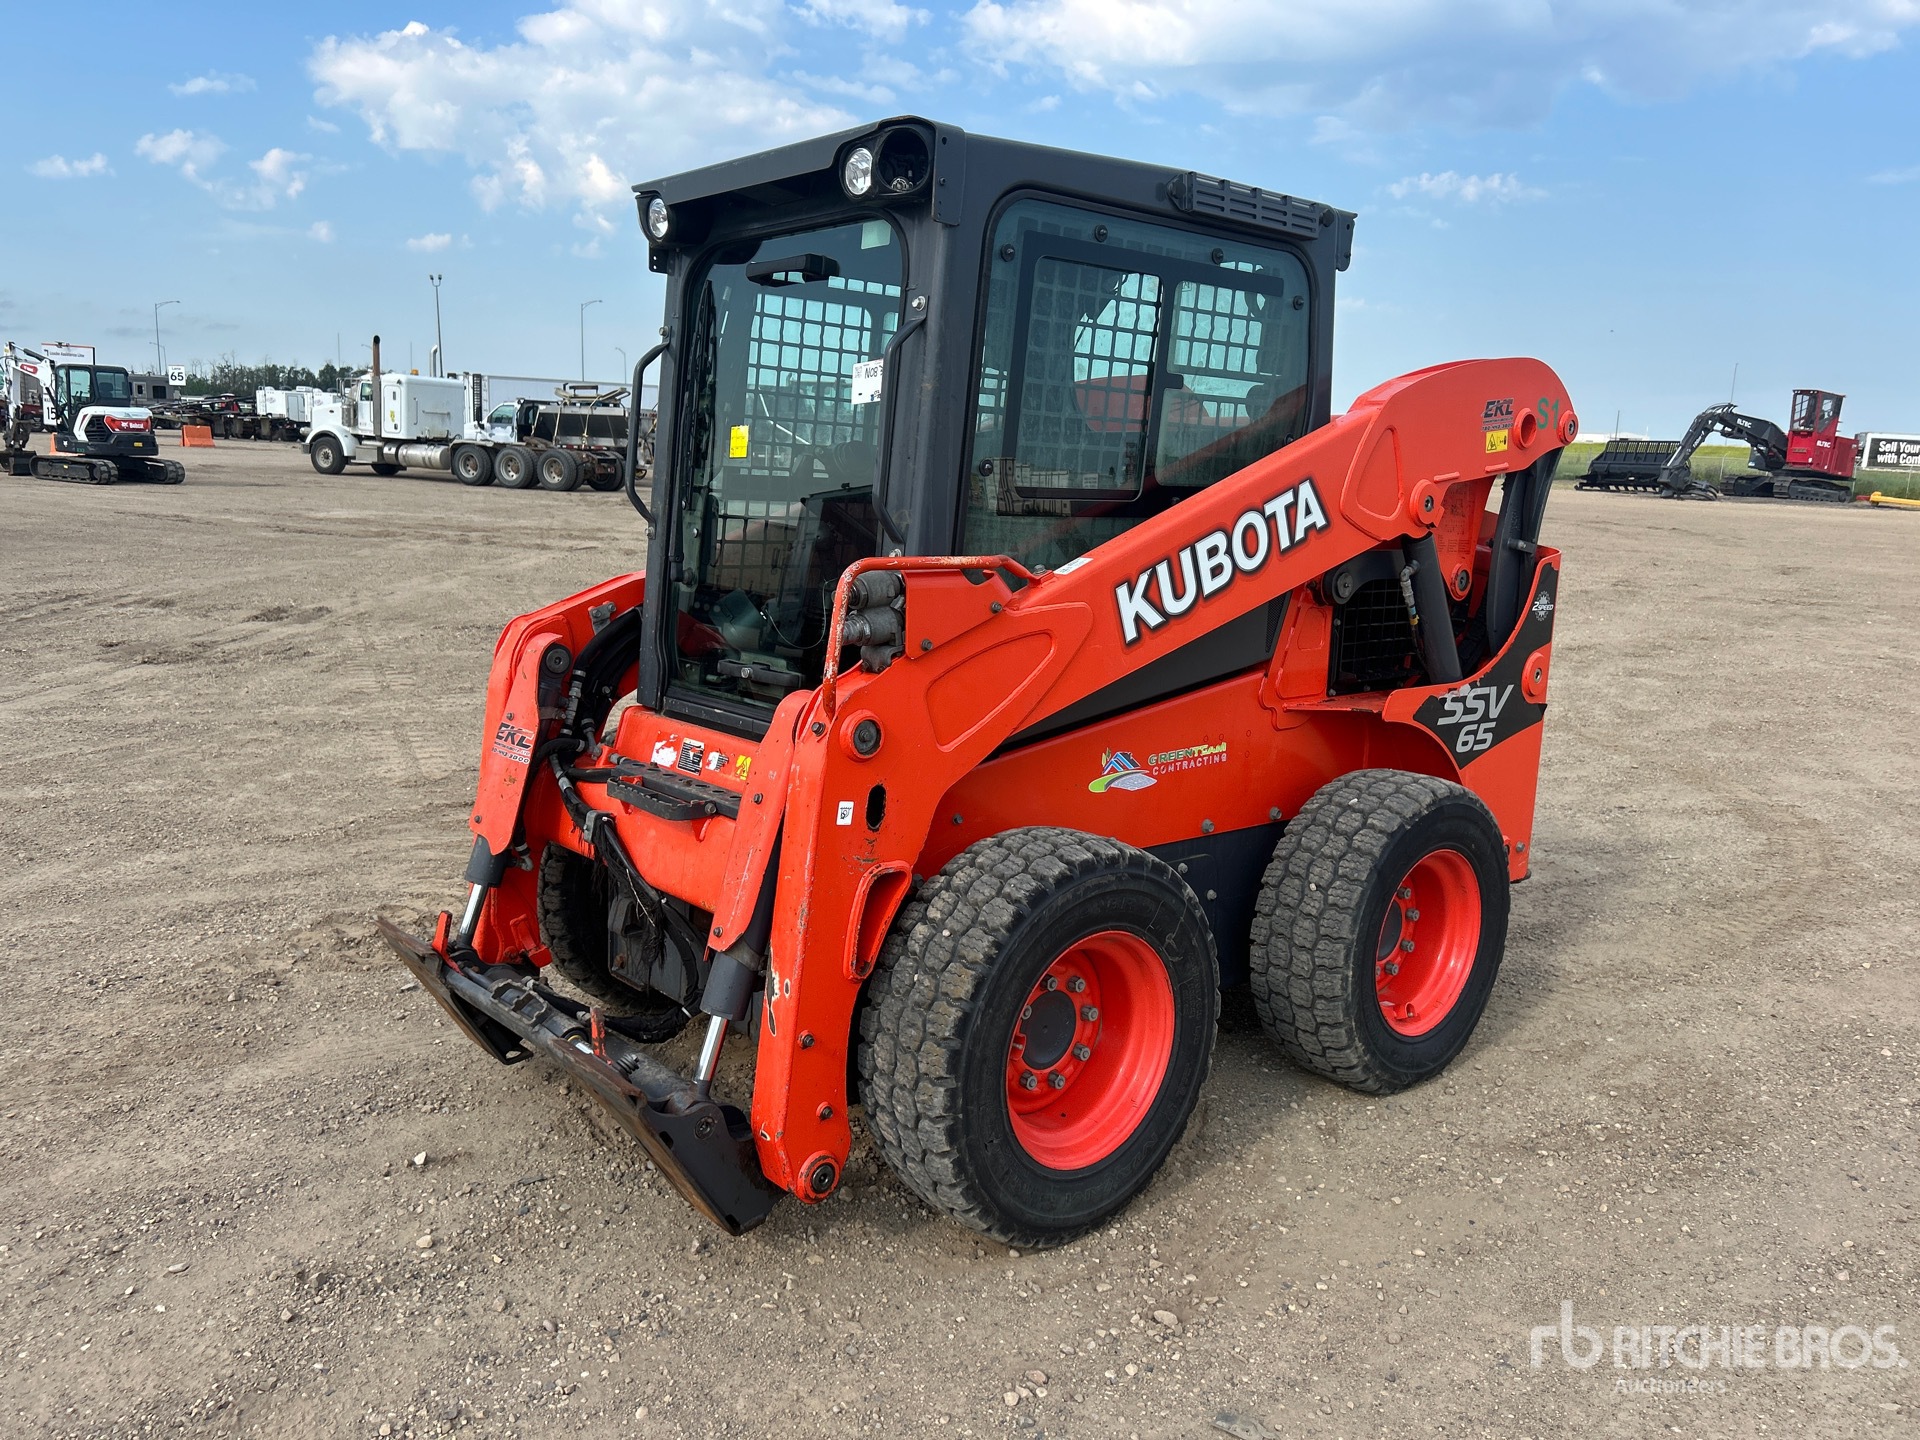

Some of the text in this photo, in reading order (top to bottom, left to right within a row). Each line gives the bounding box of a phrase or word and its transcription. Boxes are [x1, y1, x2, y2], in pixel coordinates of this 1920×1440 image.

[170, 371, 184, 381] 65
[46, 407, 57, 420] 15
[1483, 398, 1514, 419] EKL
[1537, 397, 1560, 430] S1
[1877, 452, 1898, 464] with
[1878, 440, 1920, 454] Sell Your
[1114, 478, 1329, 646] KUBOTA
[1437, 684, 1514, 726] SSV
[495, 722, 533, 750] EKL
[1456, 721, 1496, 753] 65
[1152, 753, 1227, 776] CONTRACTING
